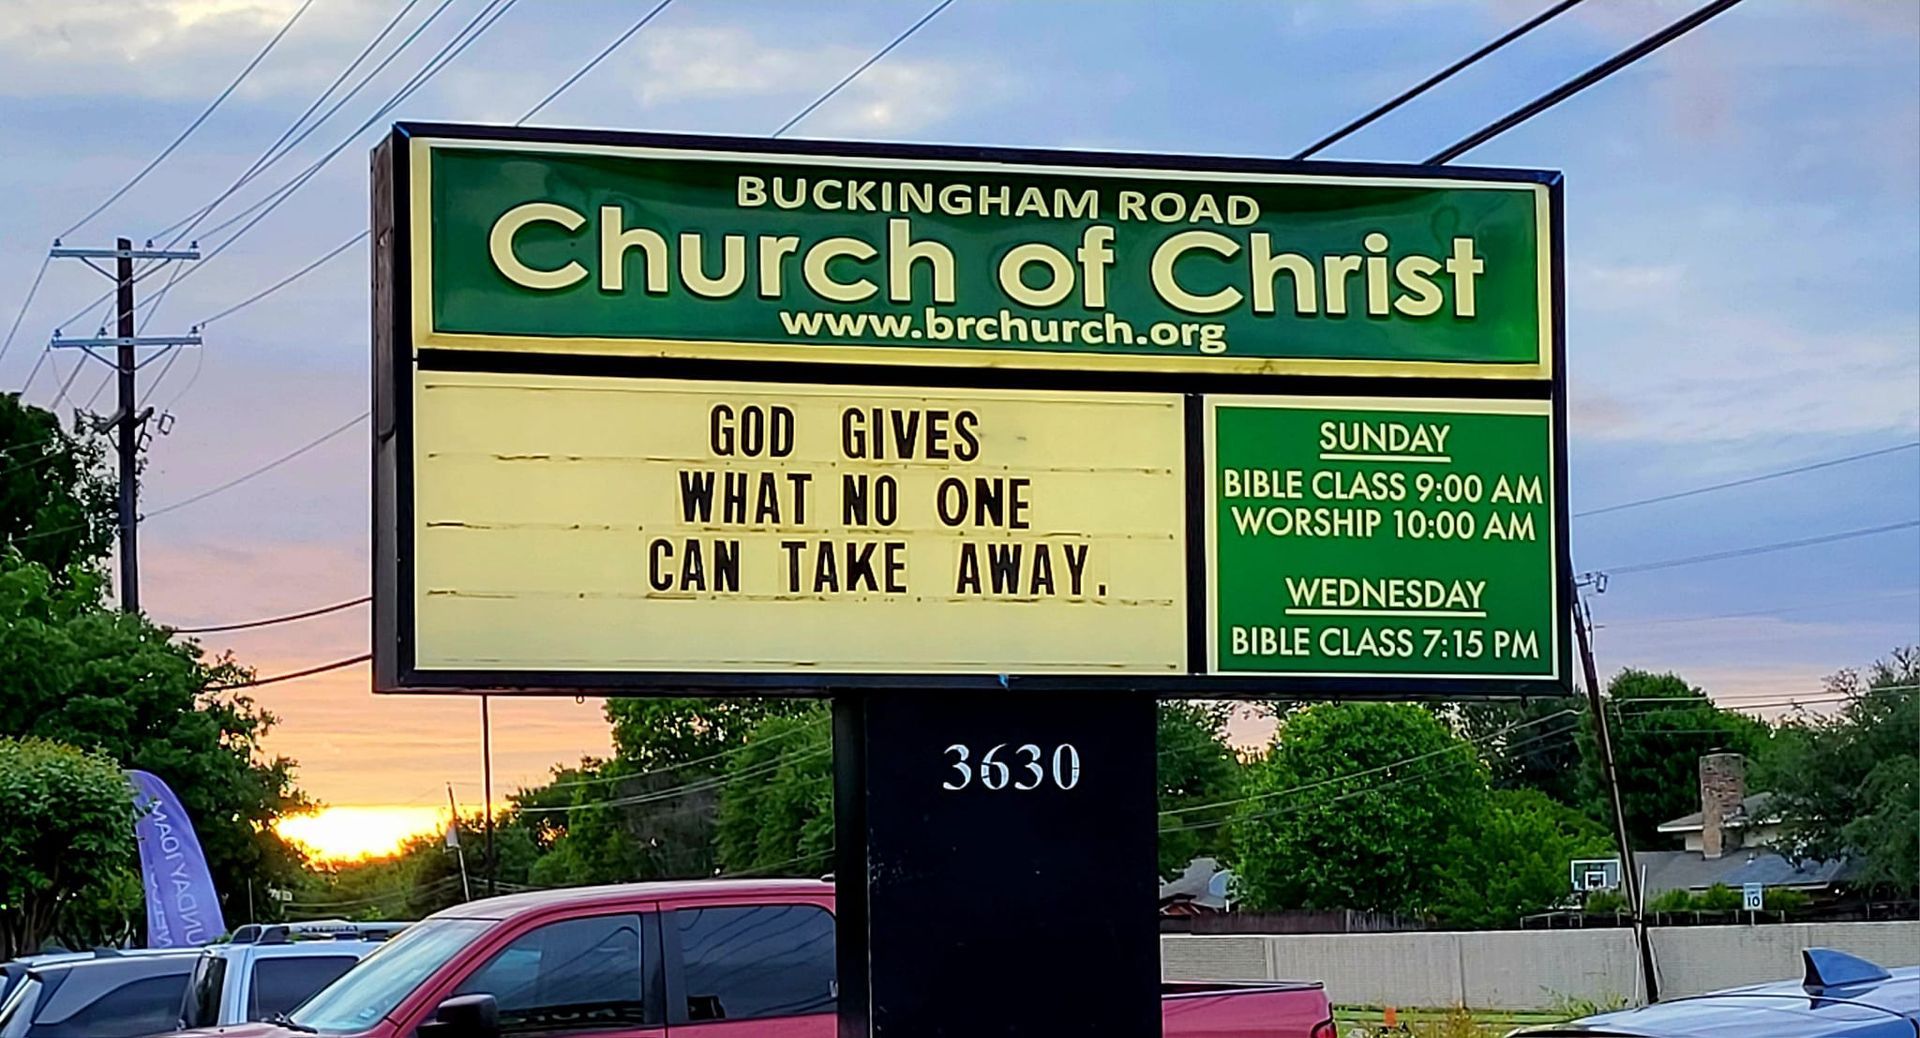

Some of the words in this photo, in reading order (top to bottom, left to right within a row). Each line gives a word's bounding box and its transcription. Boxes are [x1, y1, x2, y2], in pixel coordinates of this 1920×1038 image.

[737, 176, 1099, 219] BUCKINGHAM
[1119, 191, 1259, 225] ROAD
[489, 203, 956, 302] Church
[999, 226, 1115, 308] of
[1152, 231, 1483, 316] Christ
[779, 308, 1227, 354] www.brchurch.org
[711, 405, 794, 457] GOD
[843, 408, 978, 461] GIVES
[1320, 422, 1449, 452] SUNDAY
[680, 471, 812, 524] WHAT
[843, 475, 896, 526] NO
[937, 478, 1030, 529] ONE
[1225, 470, 1302, 498] BIBLE
[1313, 471, 1405, 500] CLASS
[1416, 474, 1482, 502] 9:00
[1491, 475, 1542, 503] AM
[1232, 507, 1381, 536] WORSHIP
[1394, 510, 1474, 539] 10:00
[1483, 512, 1535, 540] AM
[650, 539, 739, 592] CAN
[782, 541, 906, 593] TAKE
[957, 543, 1105, 596] AWAY.
[1286, 578, 1485, 608] WEDNESDAY
[1233, 627, 1309, 655] BIBLE
[1320, 628, 1413, 656] CLASS
[1423, 630, 1482, 657] 7:15
[1495, 630, 1538, 658] PM
[943, 743, 1080, 790] 3630
[1747, 896, 1760, 907] 10
